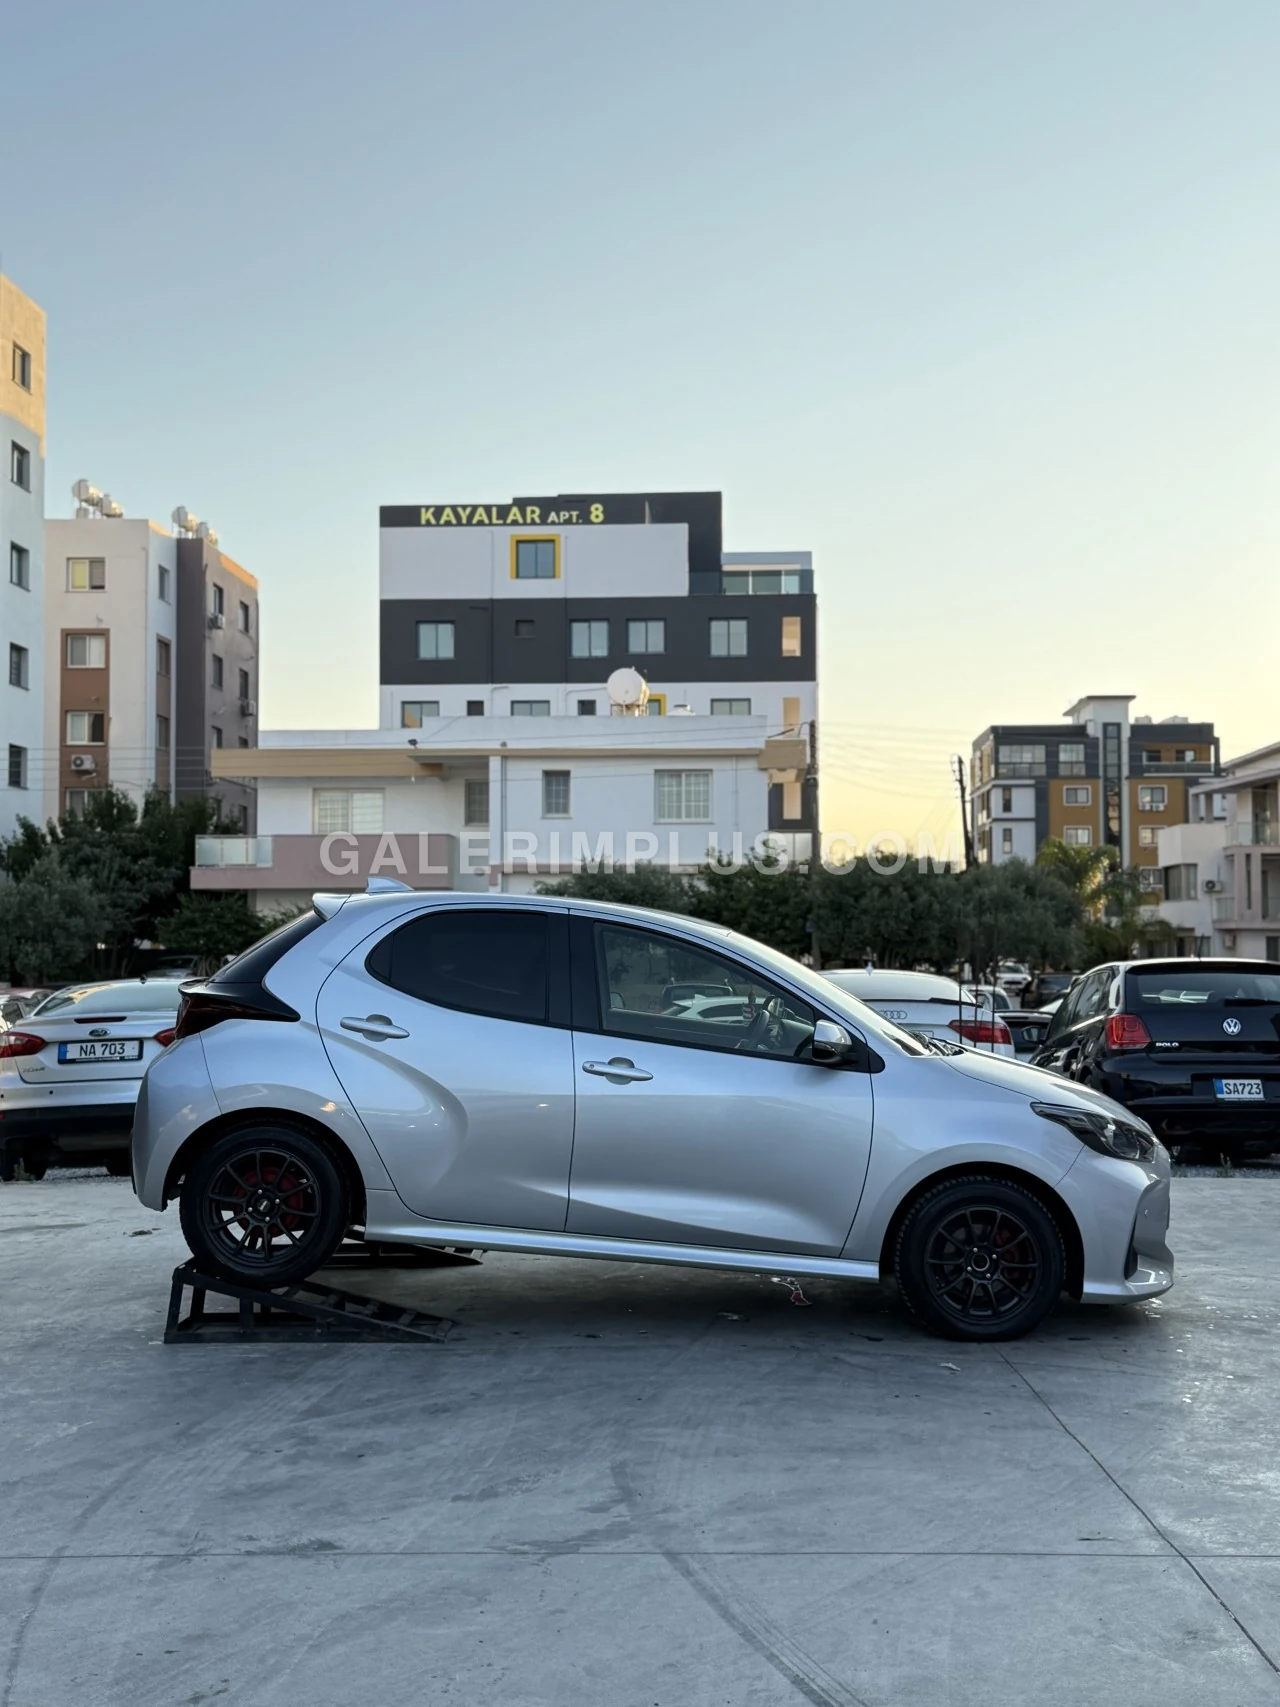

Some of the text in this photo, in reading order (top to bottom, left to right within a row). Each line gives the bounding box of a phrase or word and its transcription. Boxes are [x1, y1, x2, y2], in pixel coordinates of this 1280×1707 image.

[420, 503, 604, 525] KAYALAR APT. 8
[79, 1042, 126, 1057] NA 703
[1224, 1082, 1262, 1095] SA723
